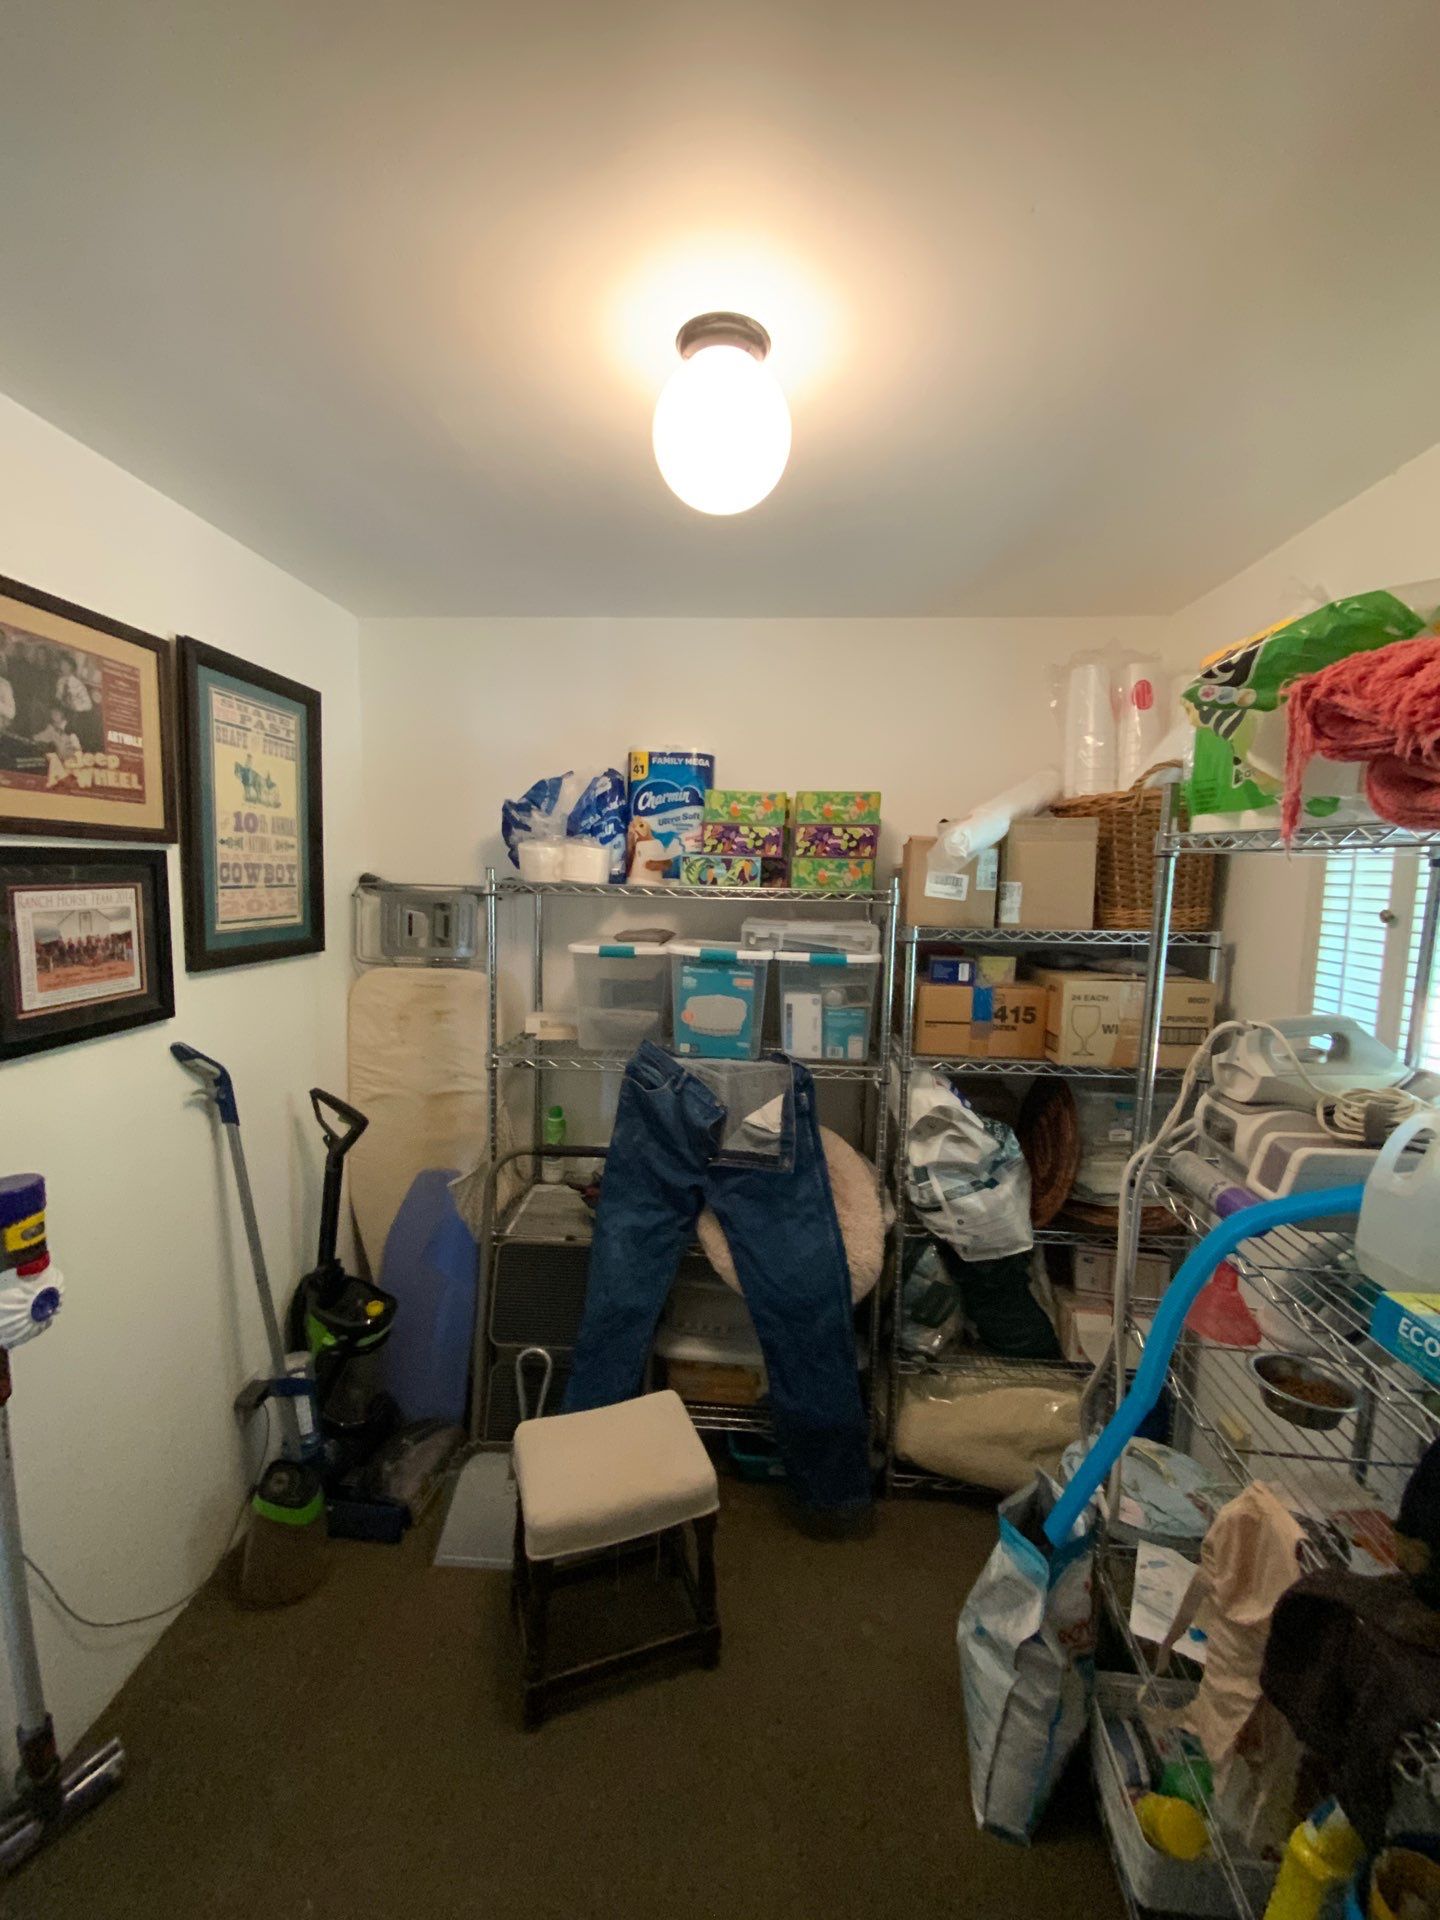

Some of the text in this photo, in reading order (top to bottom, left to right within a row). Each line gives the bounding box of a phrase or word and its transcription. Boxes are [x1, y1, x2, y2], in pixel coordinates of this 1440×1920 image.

[239, 713, 295, 738] PAST
[633, 765, 645, 774] 41
[652, 757, 684, 766] FAMILY
[685, 758, 710, 768] MEGA
[72, 768, 143, 790] WHEEL
[638, 791, 690, 811] Charmin
[658, 812, 700, 826] Ultra Soft
[219, 862, 297, 884] COWBOY
[1083, 994, 1109, 1002] EACH
[993, 1005, 1037, 1024] 415
[1399, 1316, 1440, 1358] ECO
